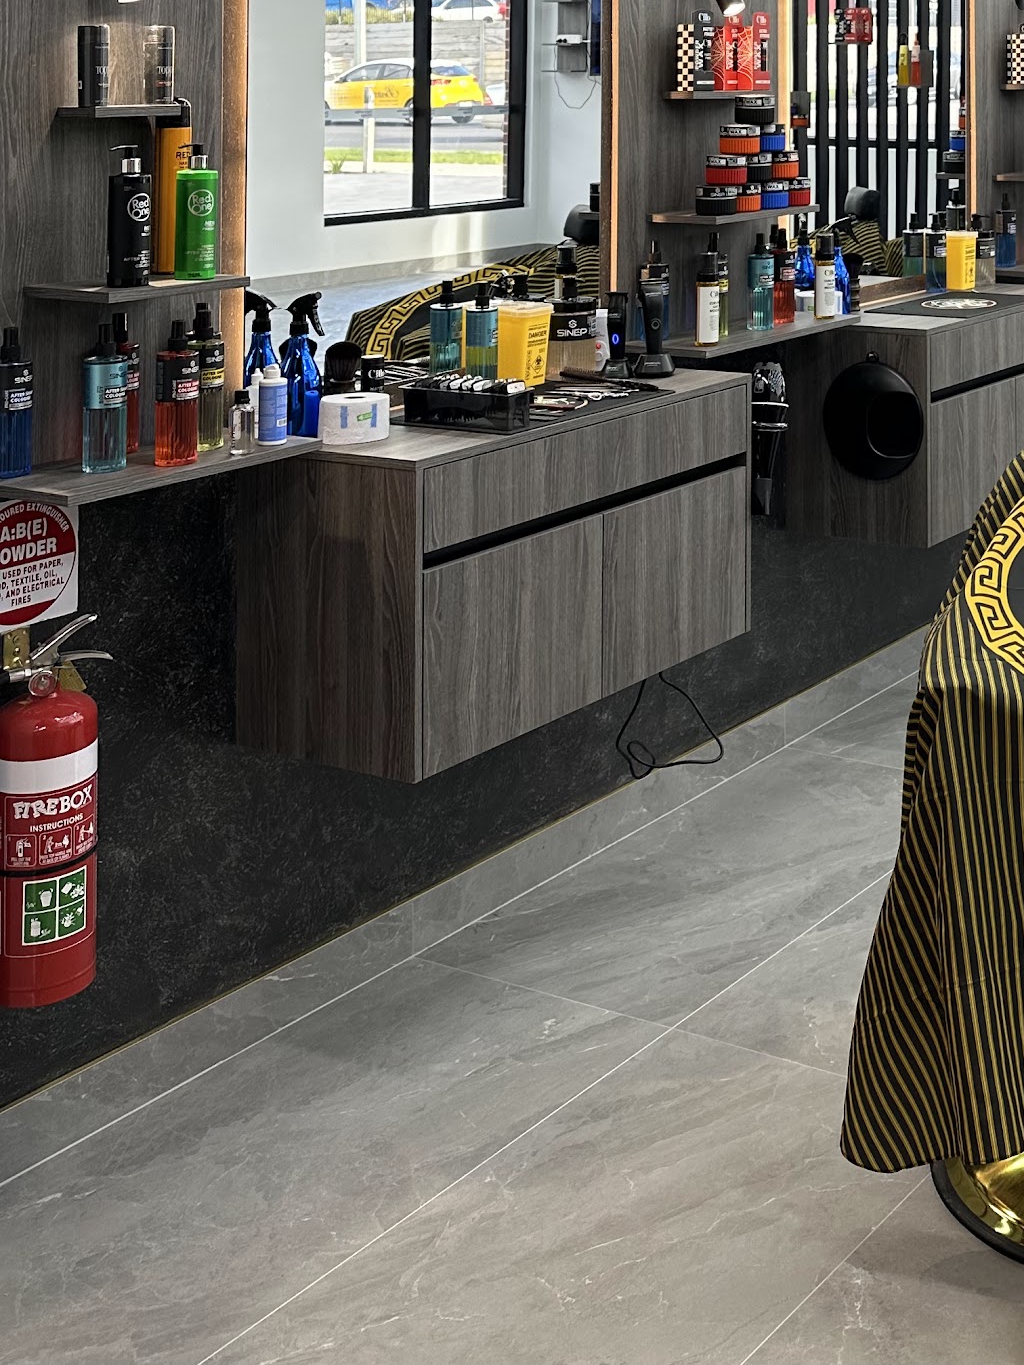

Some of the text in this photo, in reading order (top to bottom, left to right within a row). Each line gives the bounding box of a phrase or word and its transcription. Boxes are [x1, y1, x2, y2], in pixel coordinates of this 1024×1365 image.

[132, 198, 149, 210] Red
[192, 194, 211, 205] Red
[131, 207, 150, 219] One
[191, 203, 212, 214] One
[528, 330, 547, 339] DANGER
[557, 328, 588, 337] SINEP
[0, 503, 70, 533] OURED EXTINGUISHER
[0, 537, 57, 565] OWDER
[2, 558, 64, 580] USED FOR PAPER,
[11, 573, 42, 587] TEXTILE,
[44, 569, 58, 579] OIL,
[5, 588, 20, 599] AND
[22, 577, 65, 594] ELECTRICAL
[11, 594, 31, 607] FIRES
[12, 783, 93, 819] FIREBOX
[29, 812, 84, 833] INSTRUCTIONS
